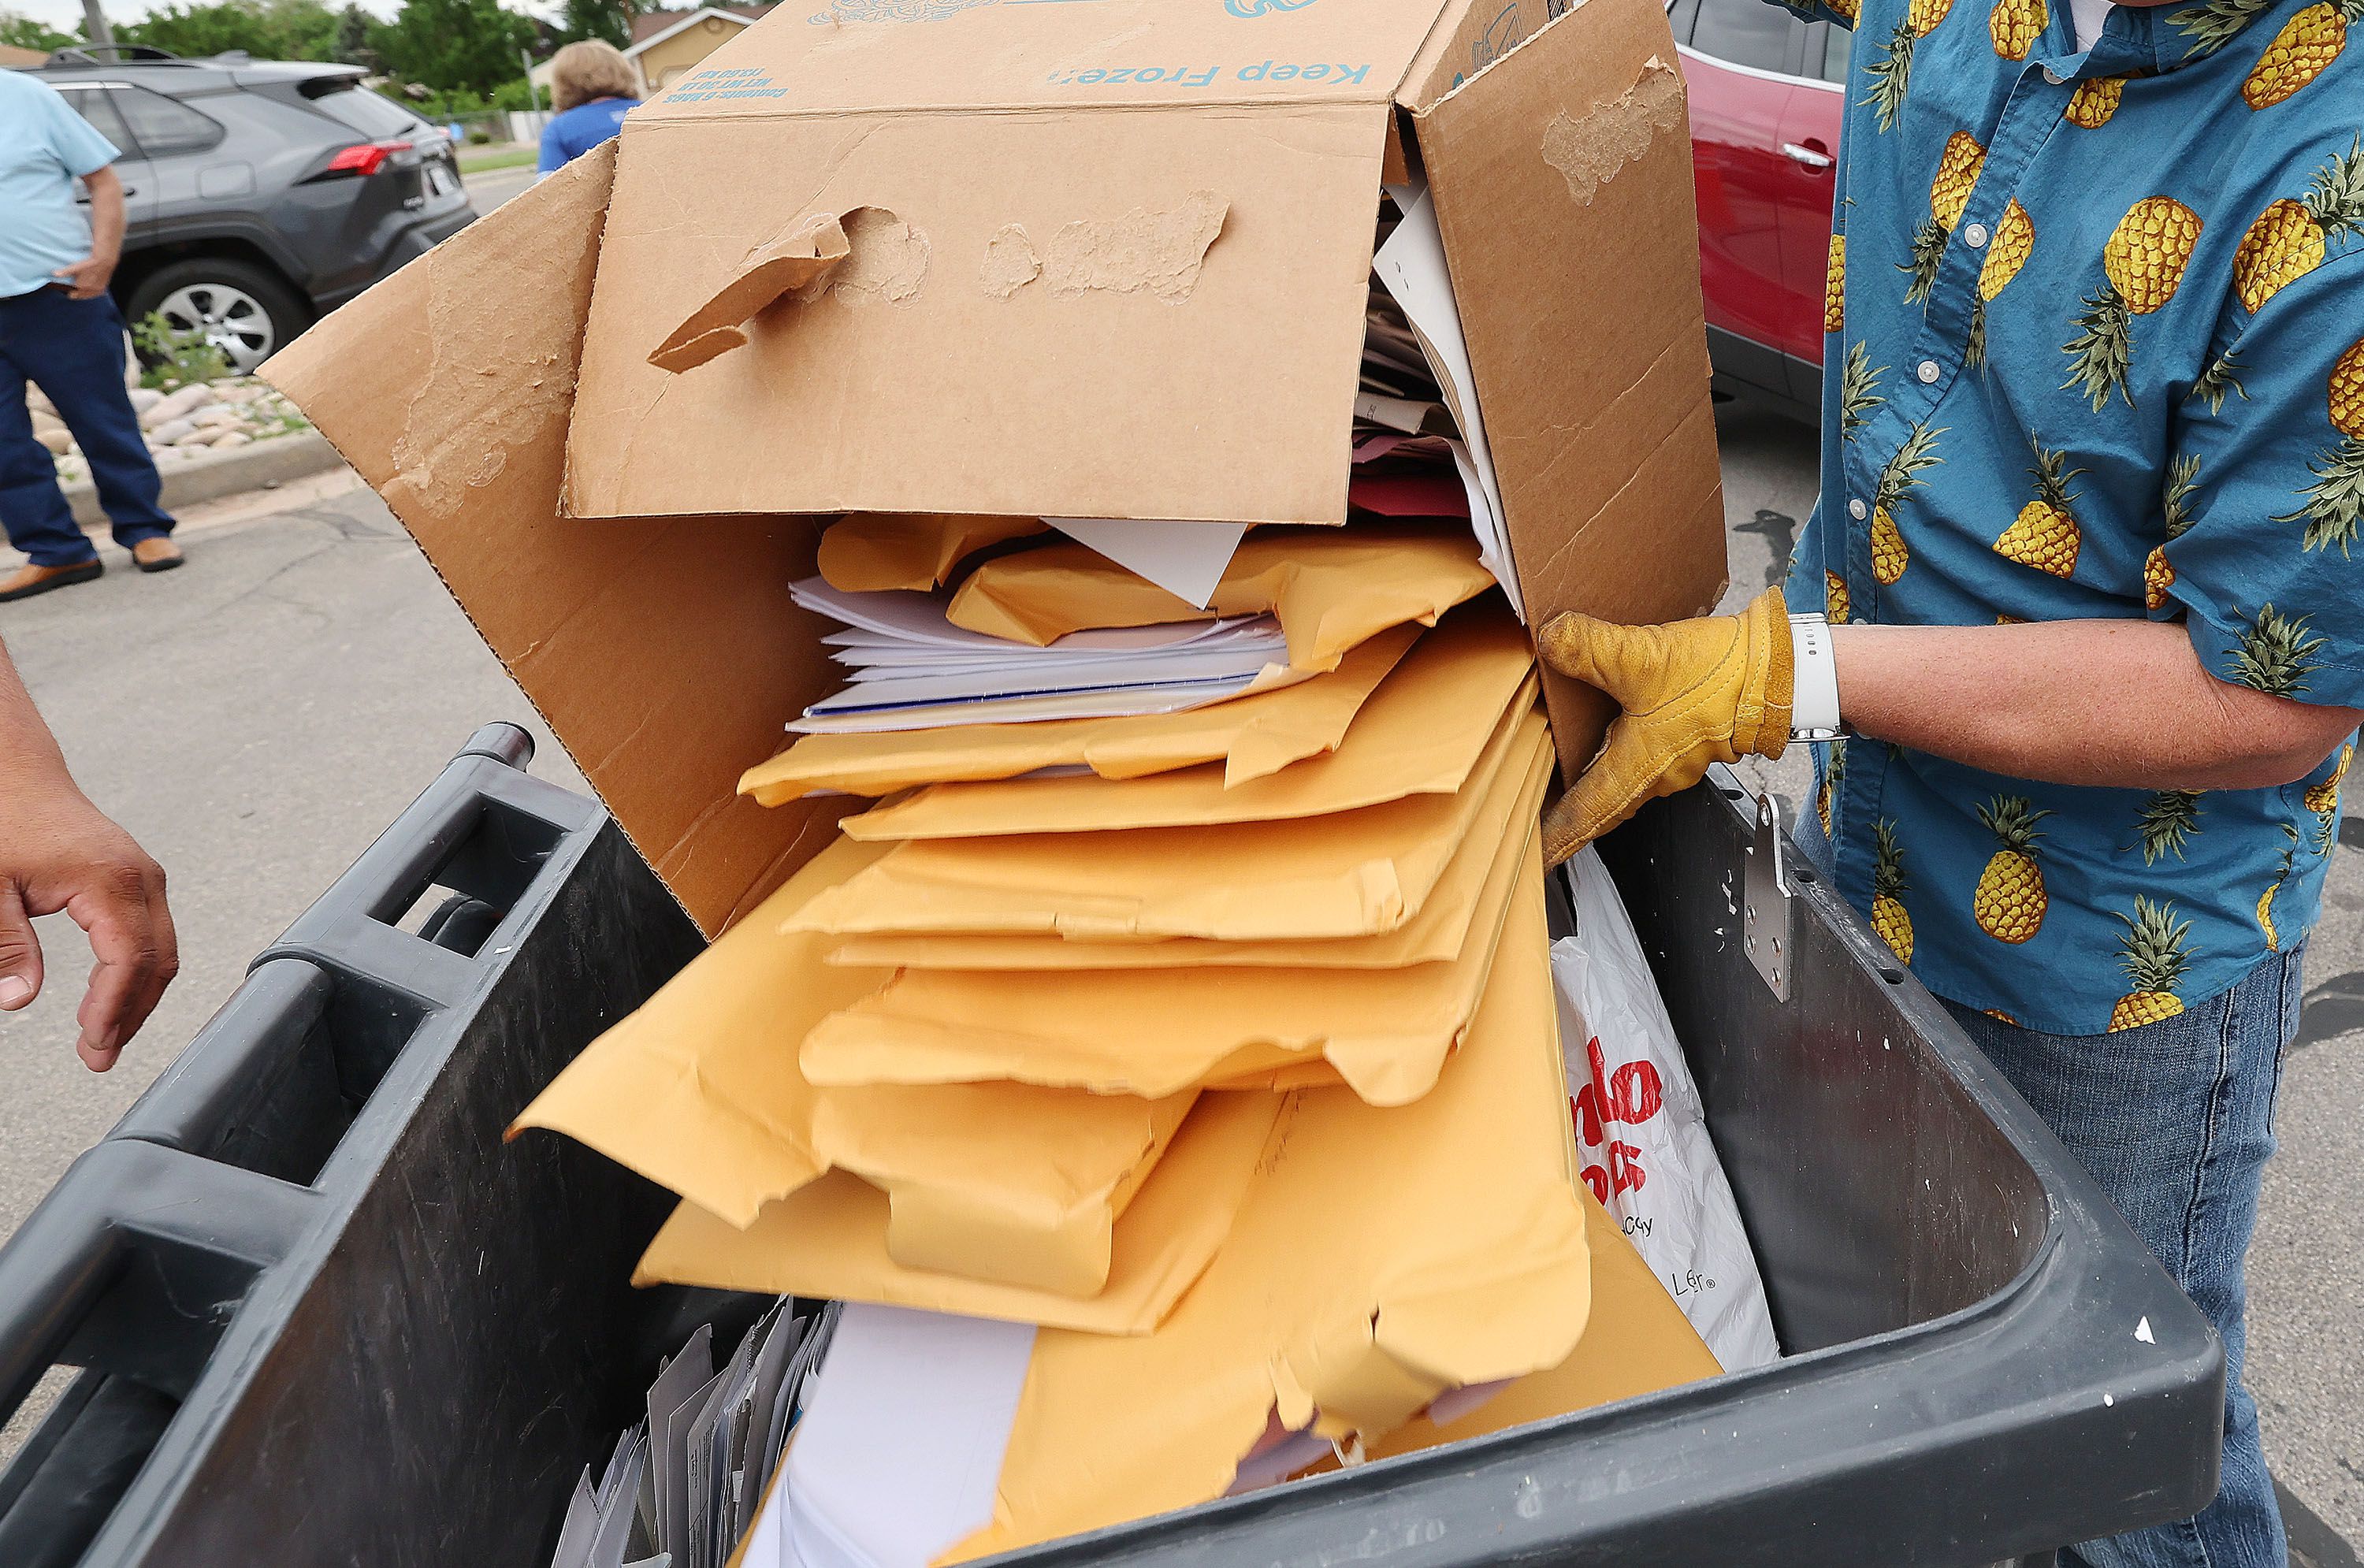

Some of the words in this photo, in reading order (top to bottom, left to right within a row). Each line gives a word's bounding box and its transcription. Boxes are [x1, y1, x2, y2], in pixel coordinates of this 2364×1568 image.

[1046, 65, 1221, 87] Froze
[1236, 60, 1371, 84] Keep
[716, 88, 789, 98] Contents:
